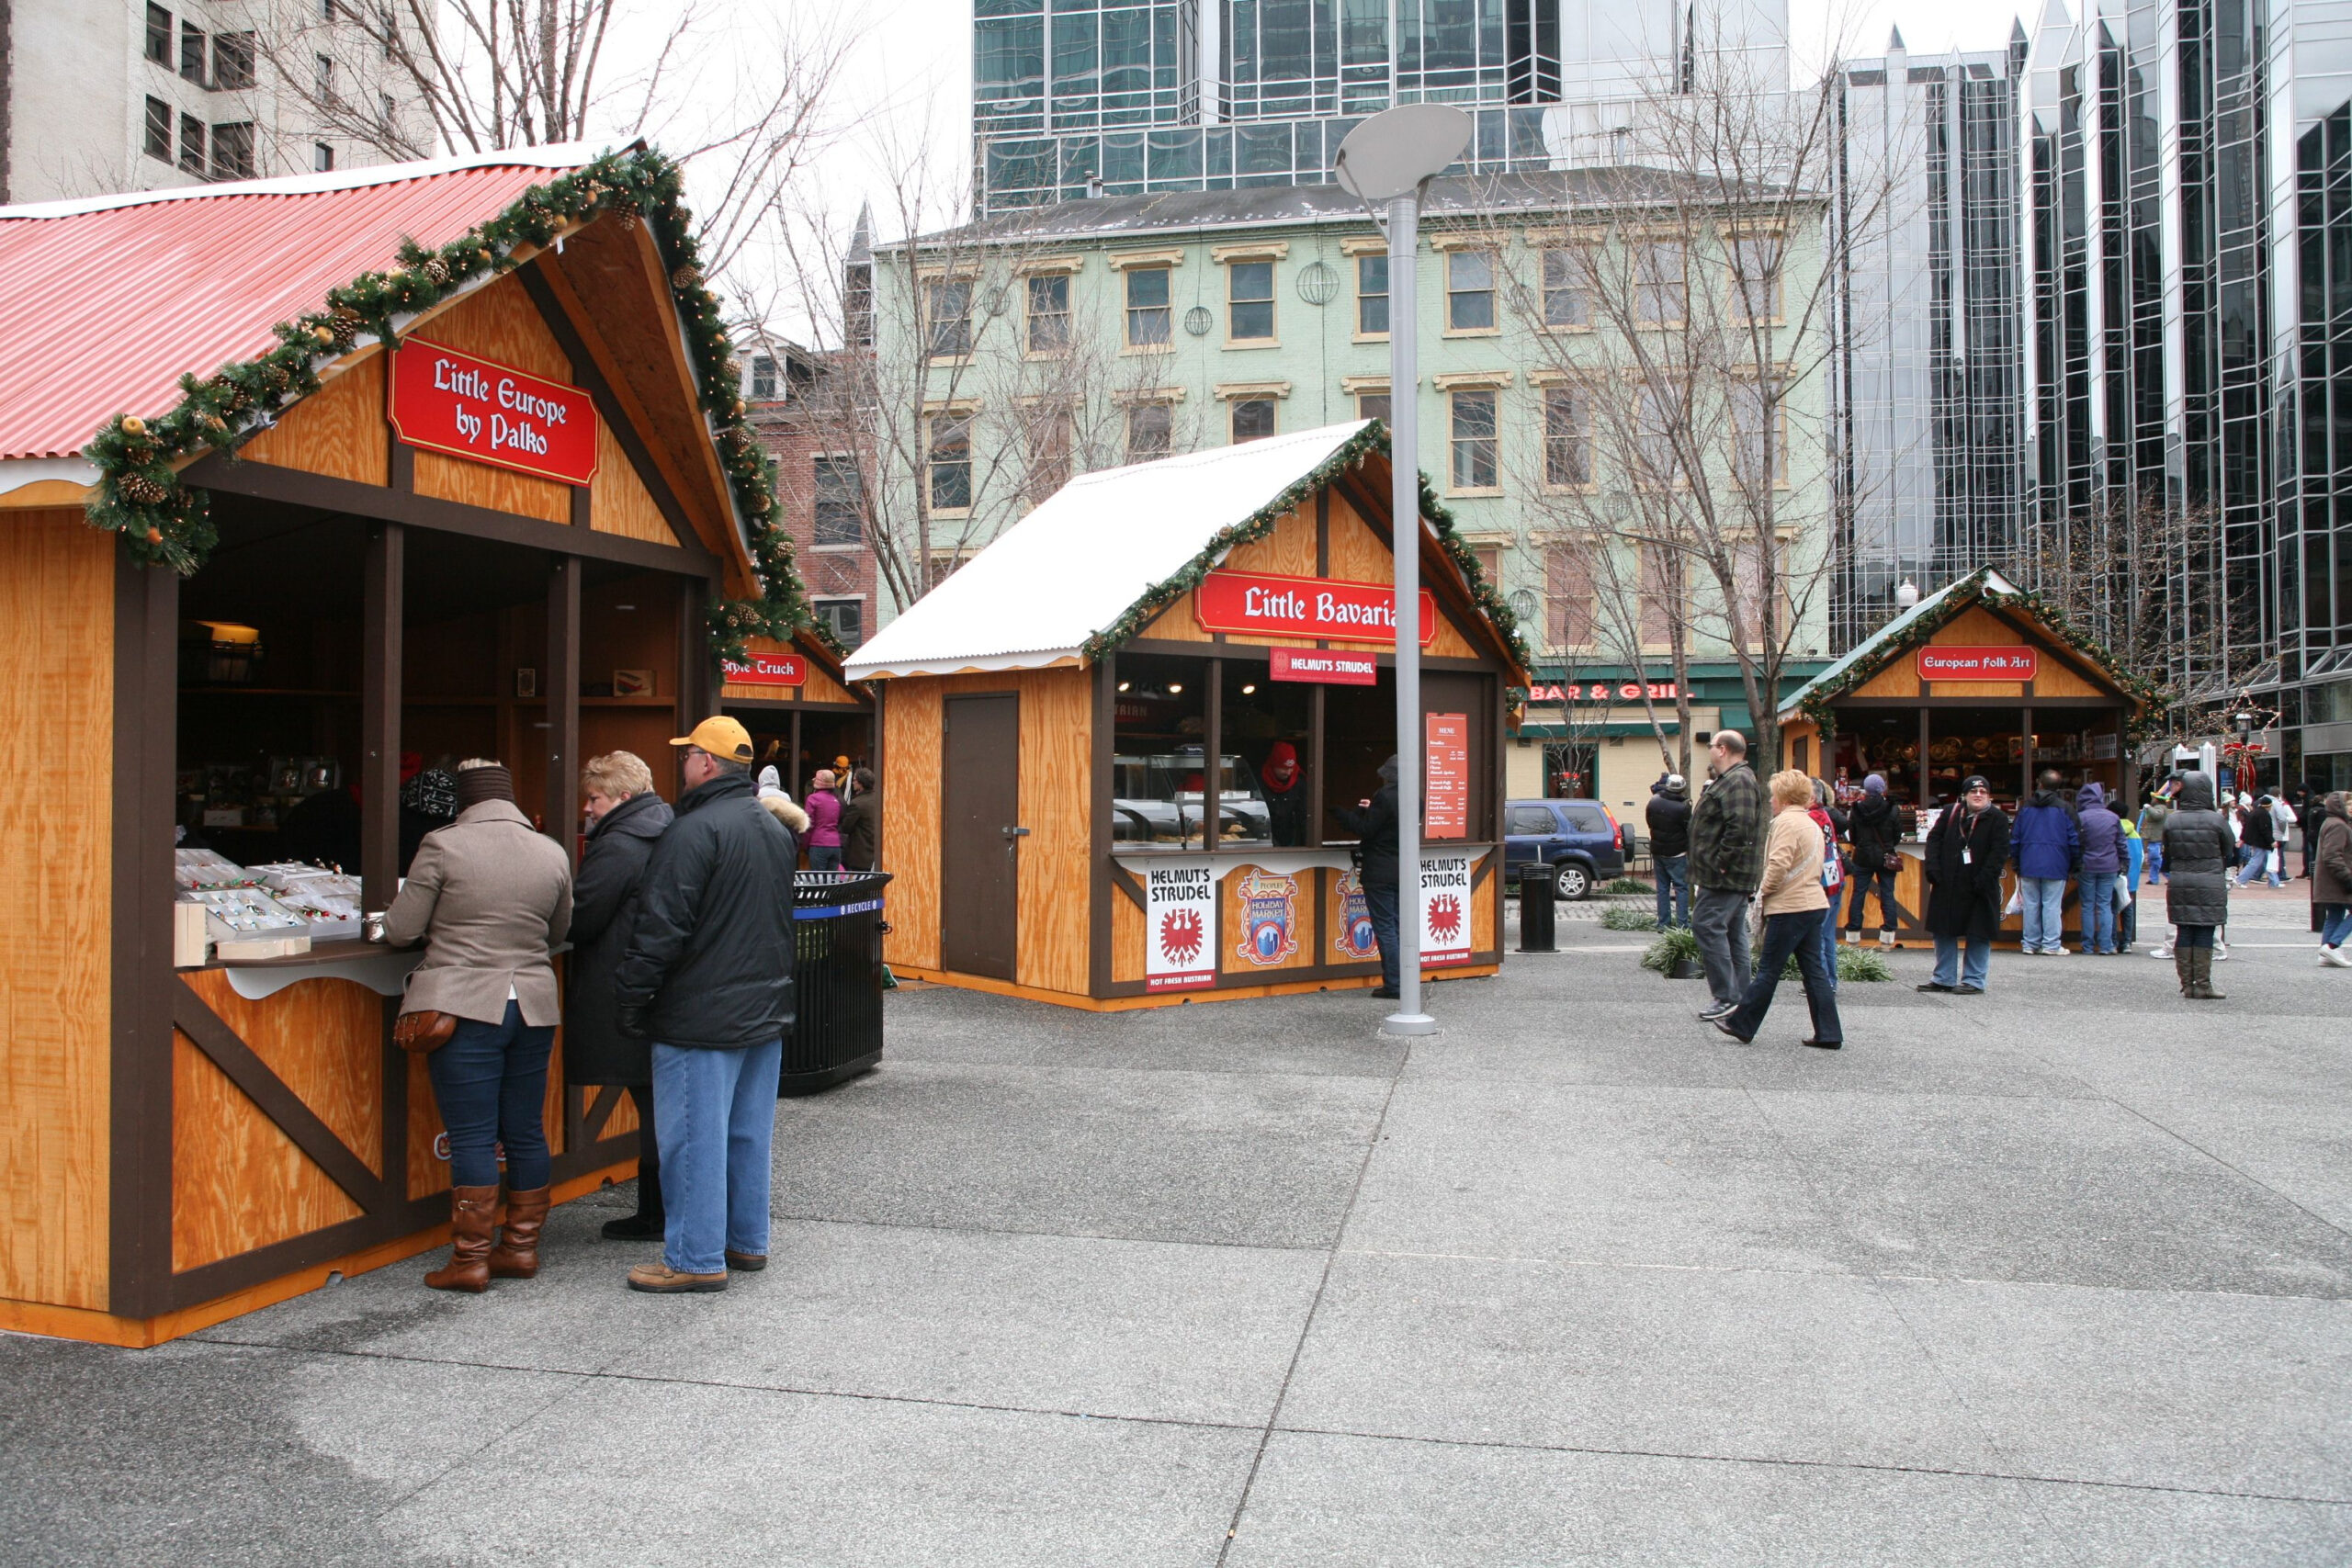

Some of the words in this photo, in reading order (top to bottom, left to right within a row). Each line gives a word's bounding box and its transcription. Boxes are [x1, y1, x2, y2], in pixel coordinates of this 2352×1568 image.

[434, 358, 489, 401] Little
[497, 378, 567, 427] Europe
[456, 403, 481, 444] by
[490, 412, 548, 456] Palko
[1245, 586, 1306, 620] Little
[757, 660, 795, 675] Truck
[1291, 658, 1333, 671] HELMUT'S
[1335, 660, 1374, 674] STRUDEL
[1924, 656, 1979, 670] European
[2010, 656, 2030, 668] Art
[1530, 684, 1582, 701] BAR
[1589, 684, 1610, 699] &
[1420, 858, 1466, 873] HELMUT'S
[1150, 868, 1211, 885] HELMUT'S
[1421, 873, 1467, 888] STRUDEL
[1151, 885, 1211, 902] STRUDEL
[847, 901, 871, 914] RECYCLE
[1252, 899, 1284, 910] HOLIDAY
[1252, 908, 1284, 919] MARKET
[1150, 978, 1163, 987] HOT
[1164, 976, 1182, 985] FRESH
[1183, 974, 1212, 984] AUSTRIAN
